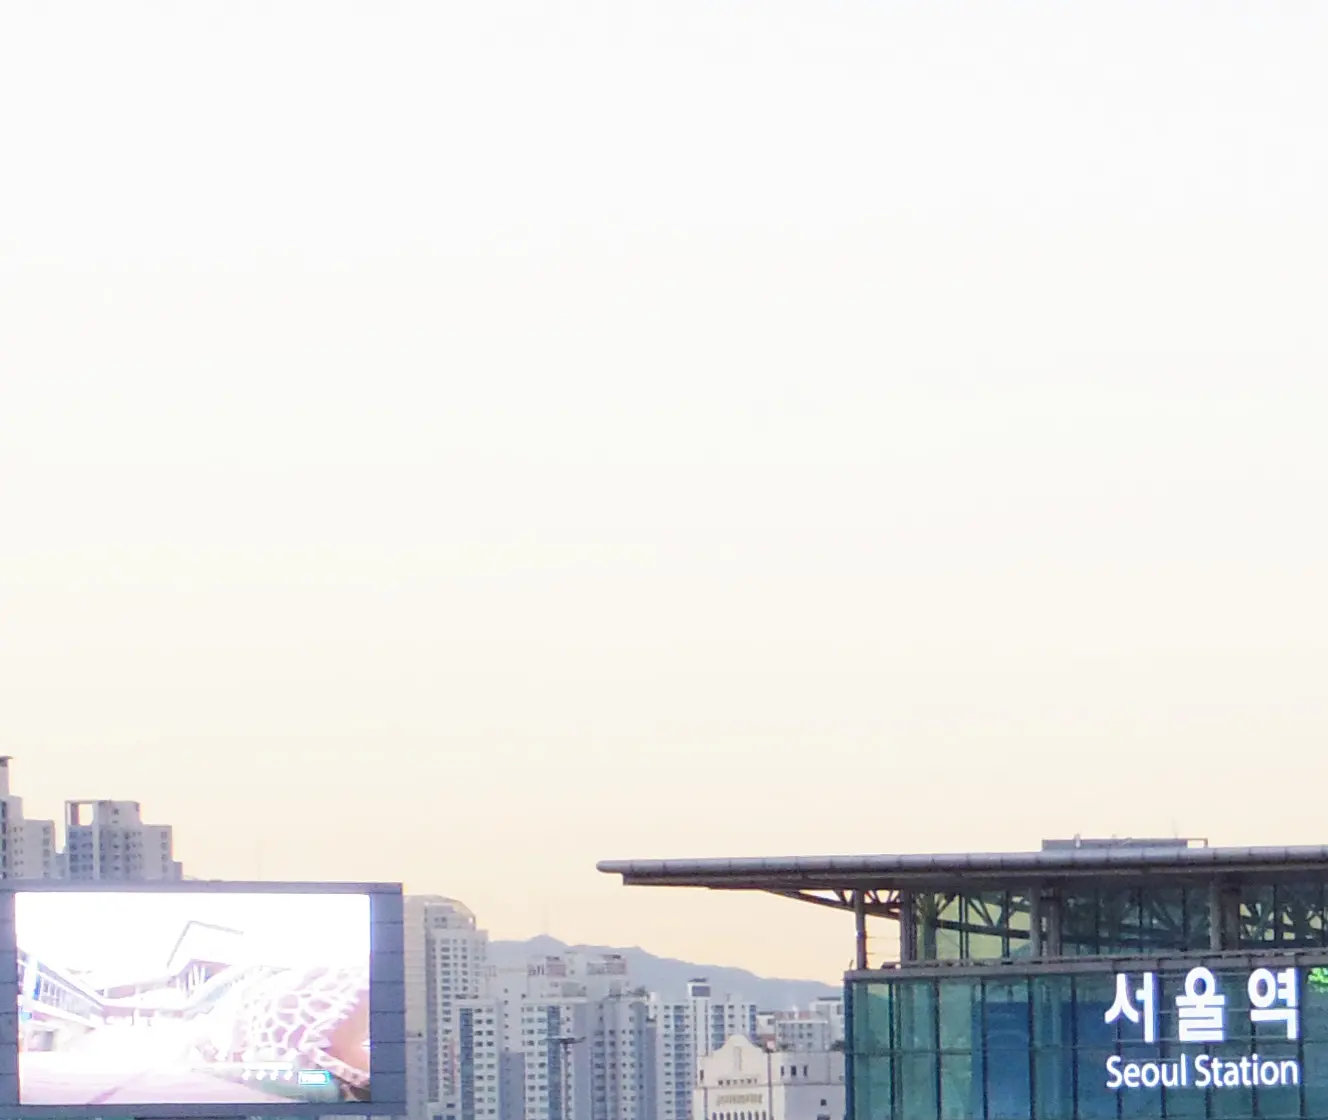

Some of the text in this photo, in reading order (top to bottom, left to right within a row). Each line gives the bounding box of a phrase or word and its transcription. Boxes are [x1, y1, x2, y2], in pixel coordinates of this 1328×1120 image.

[1104, 966, 1299, 1043] 서울역
[1106, 1053, 1299, 1088] Seoul Station
